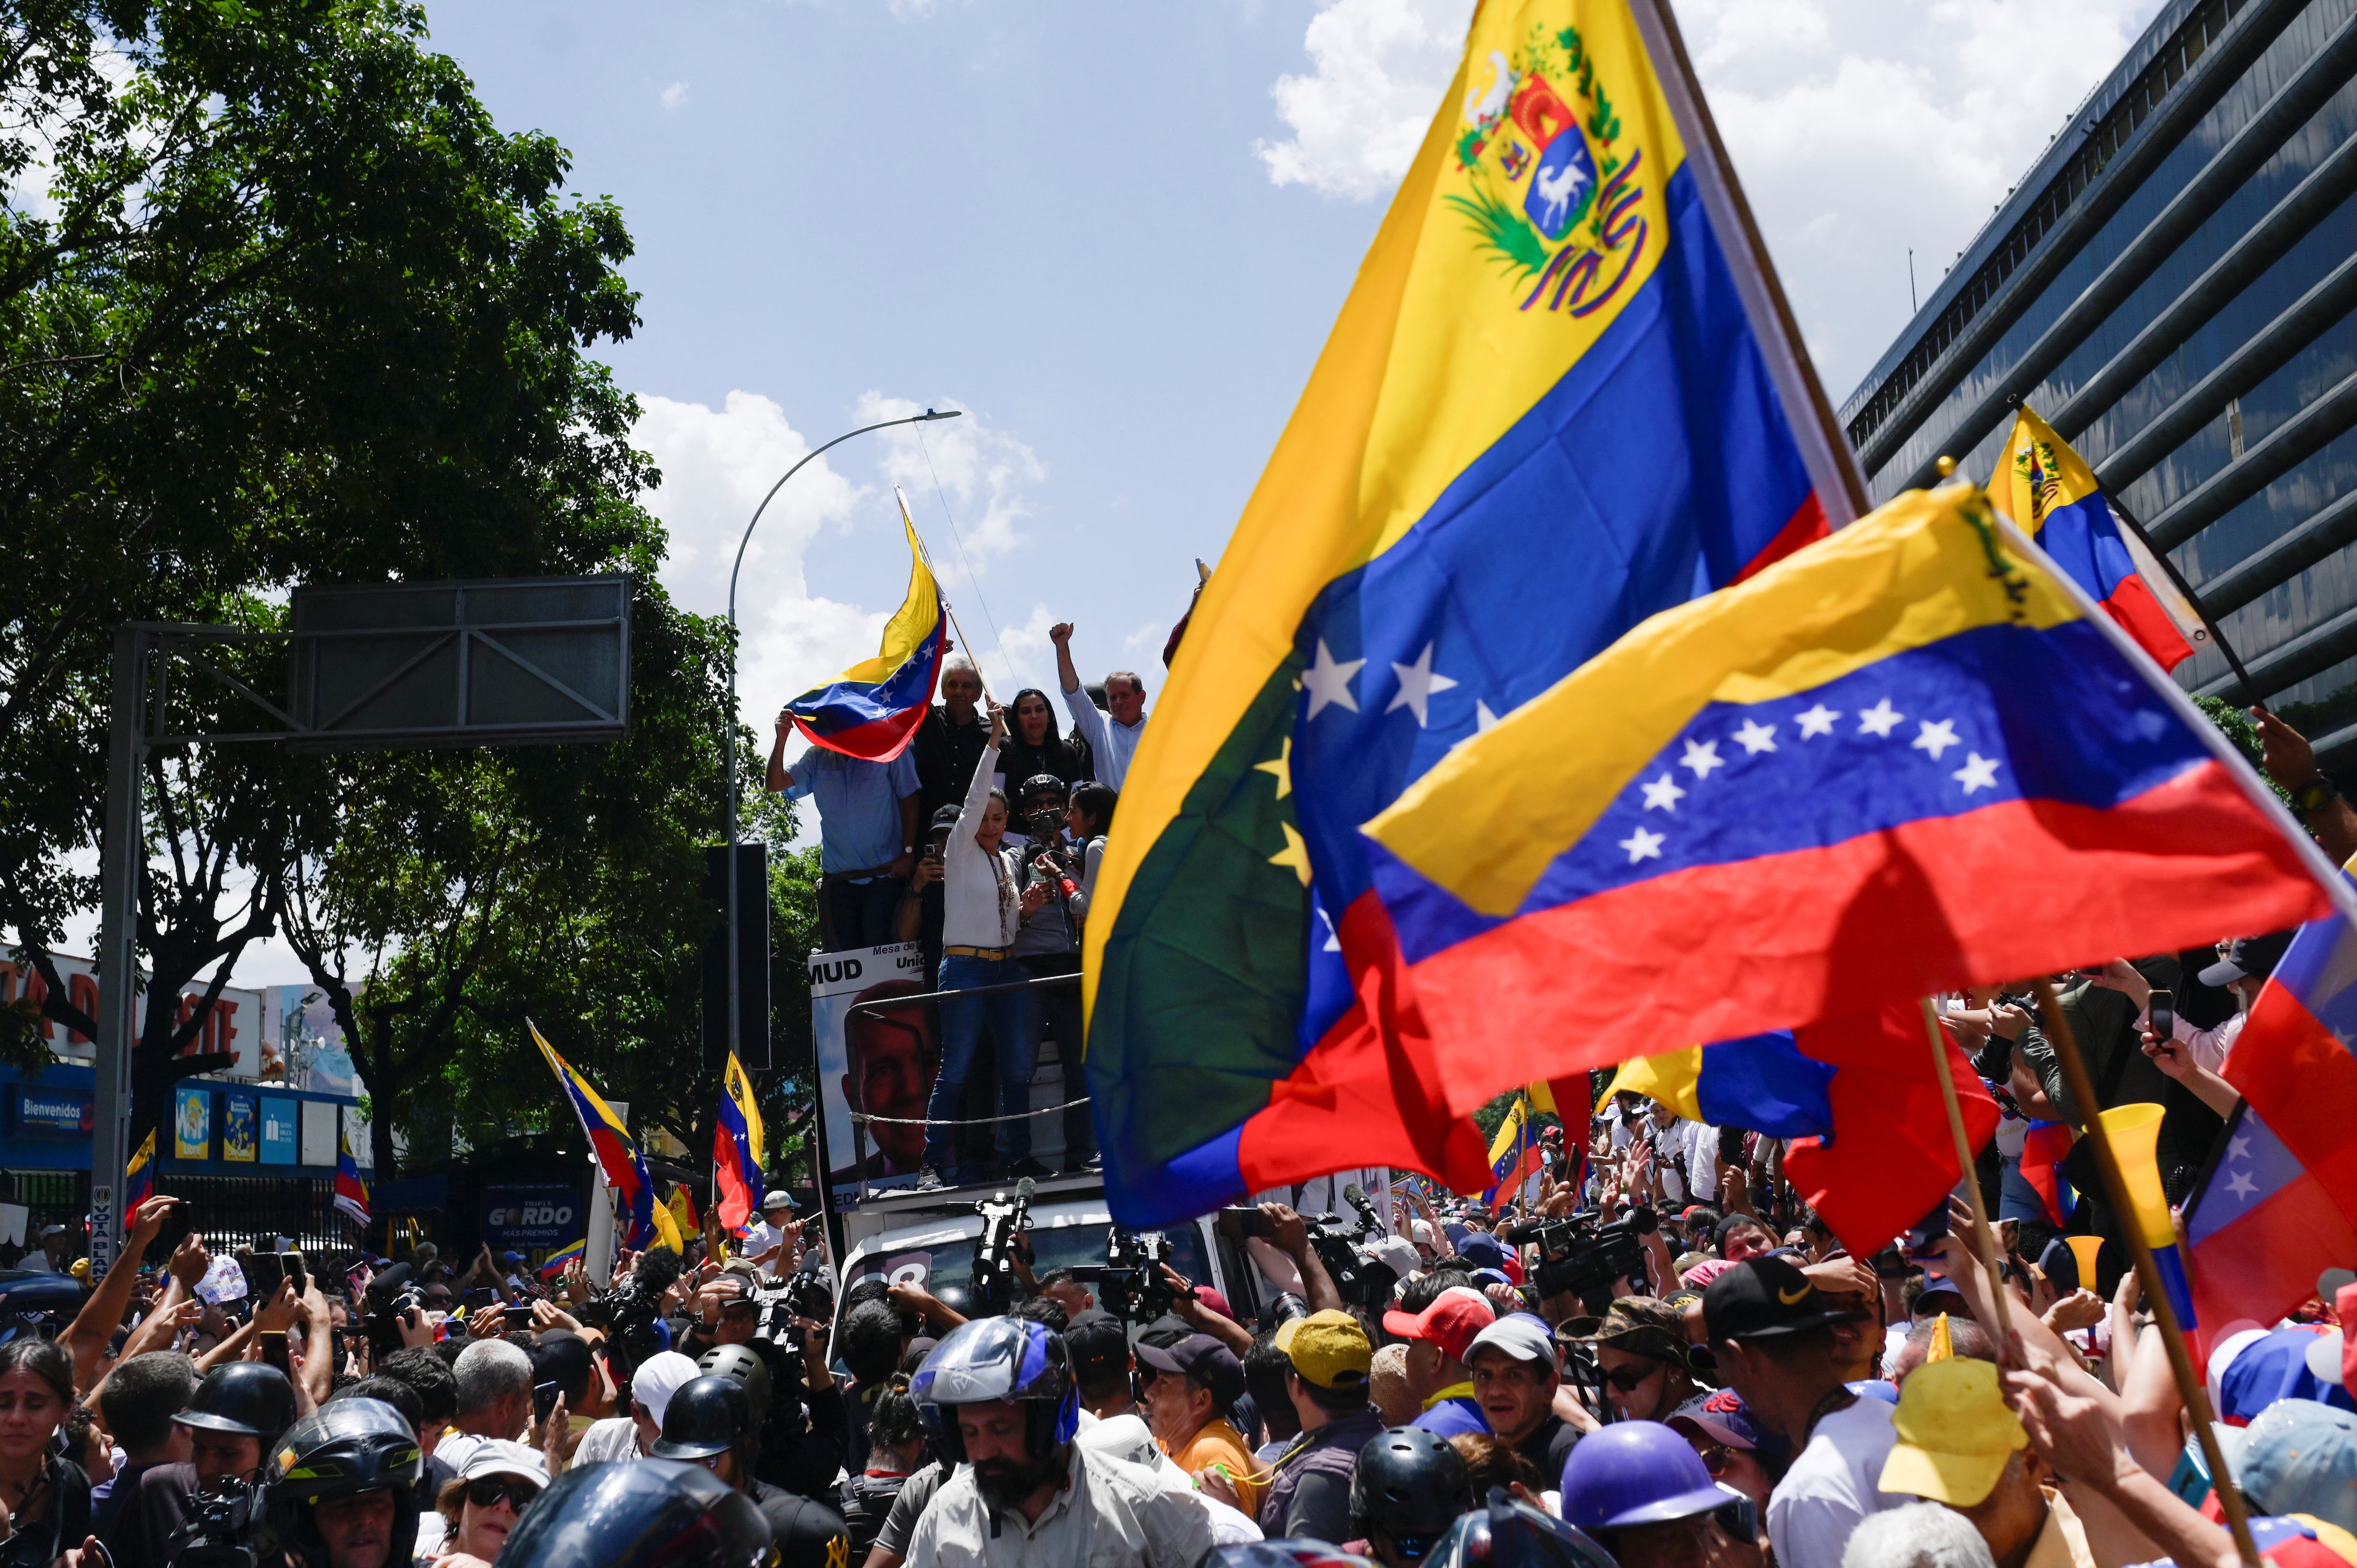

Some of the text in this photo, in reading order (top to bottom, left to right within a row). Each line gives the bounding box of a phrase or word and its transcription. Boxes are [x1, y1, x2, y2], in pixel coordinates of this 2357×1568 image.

[873, 944, 900, 956] Mesa
[903, 942, 915, 950] de
[808, 959, 863, 985] MUD
[24, 1098, 81, 1119] Bienvenidos
[183, 1142, 201, 1155] Libre
[93, 1205, 110, 1238] VOTA
